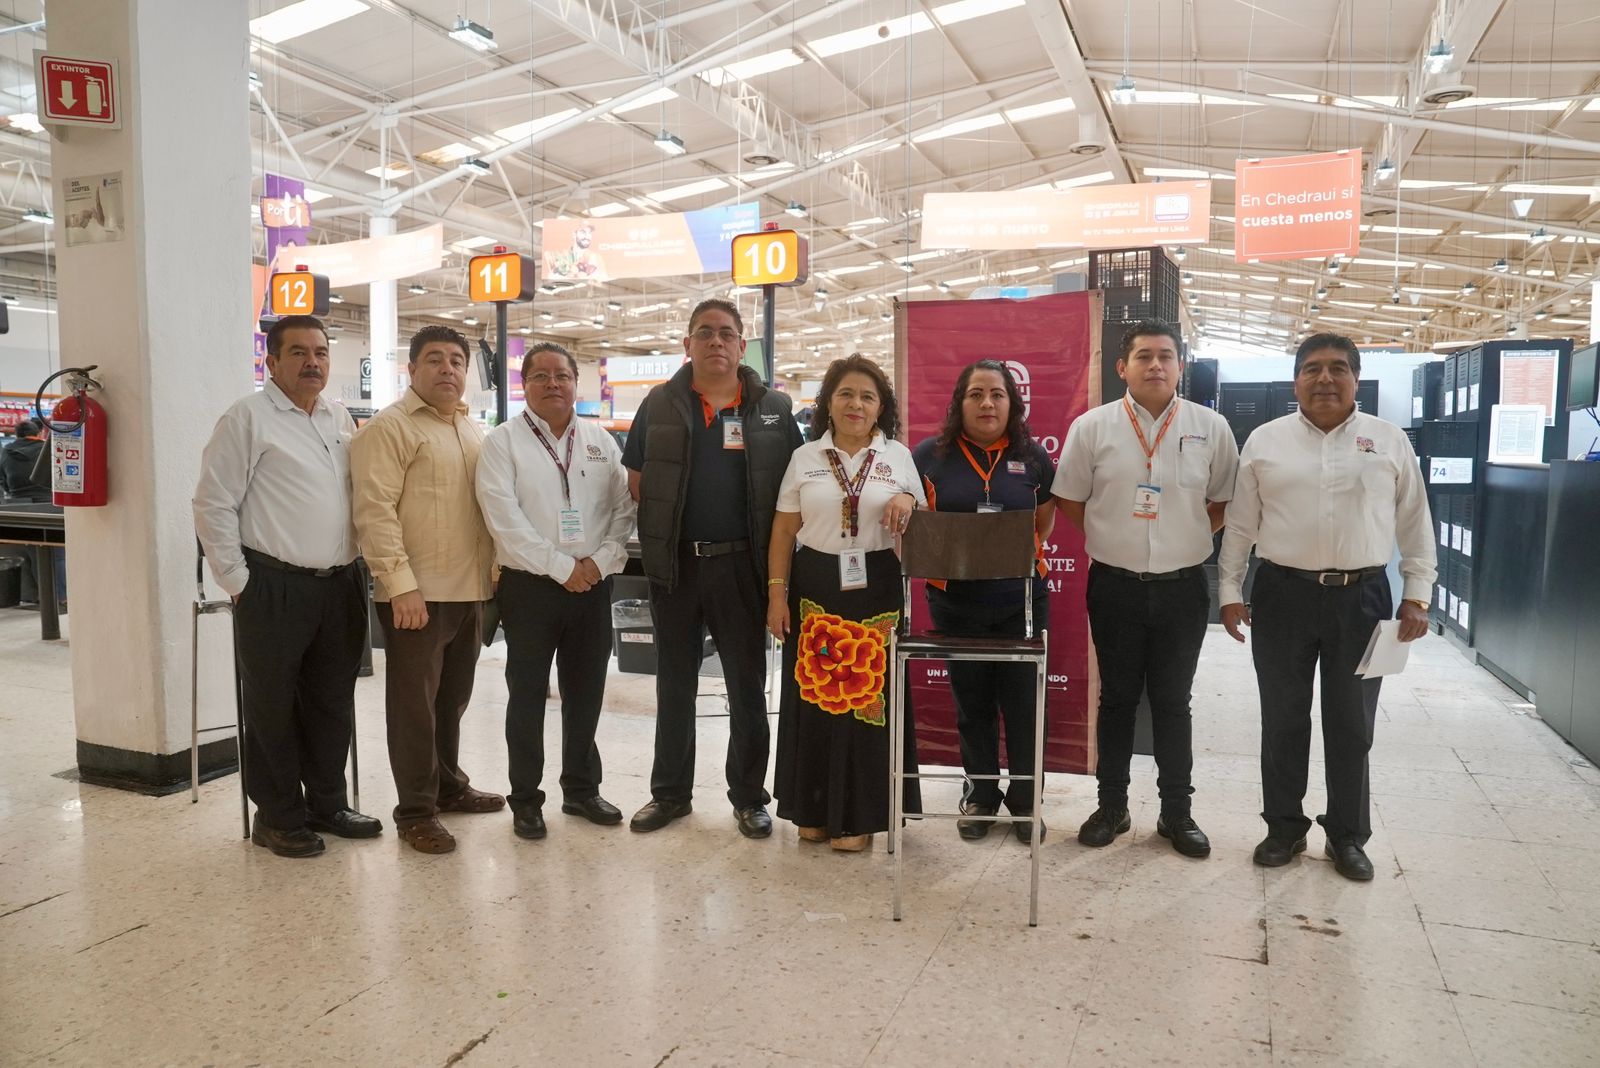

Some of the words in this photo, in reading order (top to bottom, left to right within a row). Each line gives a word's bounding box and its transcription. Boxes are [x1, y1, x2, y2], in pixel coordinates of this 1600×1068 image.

[51, 63, 90, 74] EXTINTOR
[1241, 194, 1261, 207] En
[1265, 188, 1336, 206] Chedraui
[1341, 185, 1353, 199] sí
[1242, 213, 1294, 227] cuesta
[1299, 209, 1353, 224] menos
[1002, 223, 1049, 235] nuevo
[745, 240, 787, 277] 10
[480, 262, 507, 294] 11
[280, 280, 307, 308] 12
[631, 361, 668, 376] Damas
[1432, 467, 1447, 477] 74
[869, 475, 896, 486] TRABAJO
[927, 669, 940, 678] UN
[1048, 677, 1068, 685] NDO
